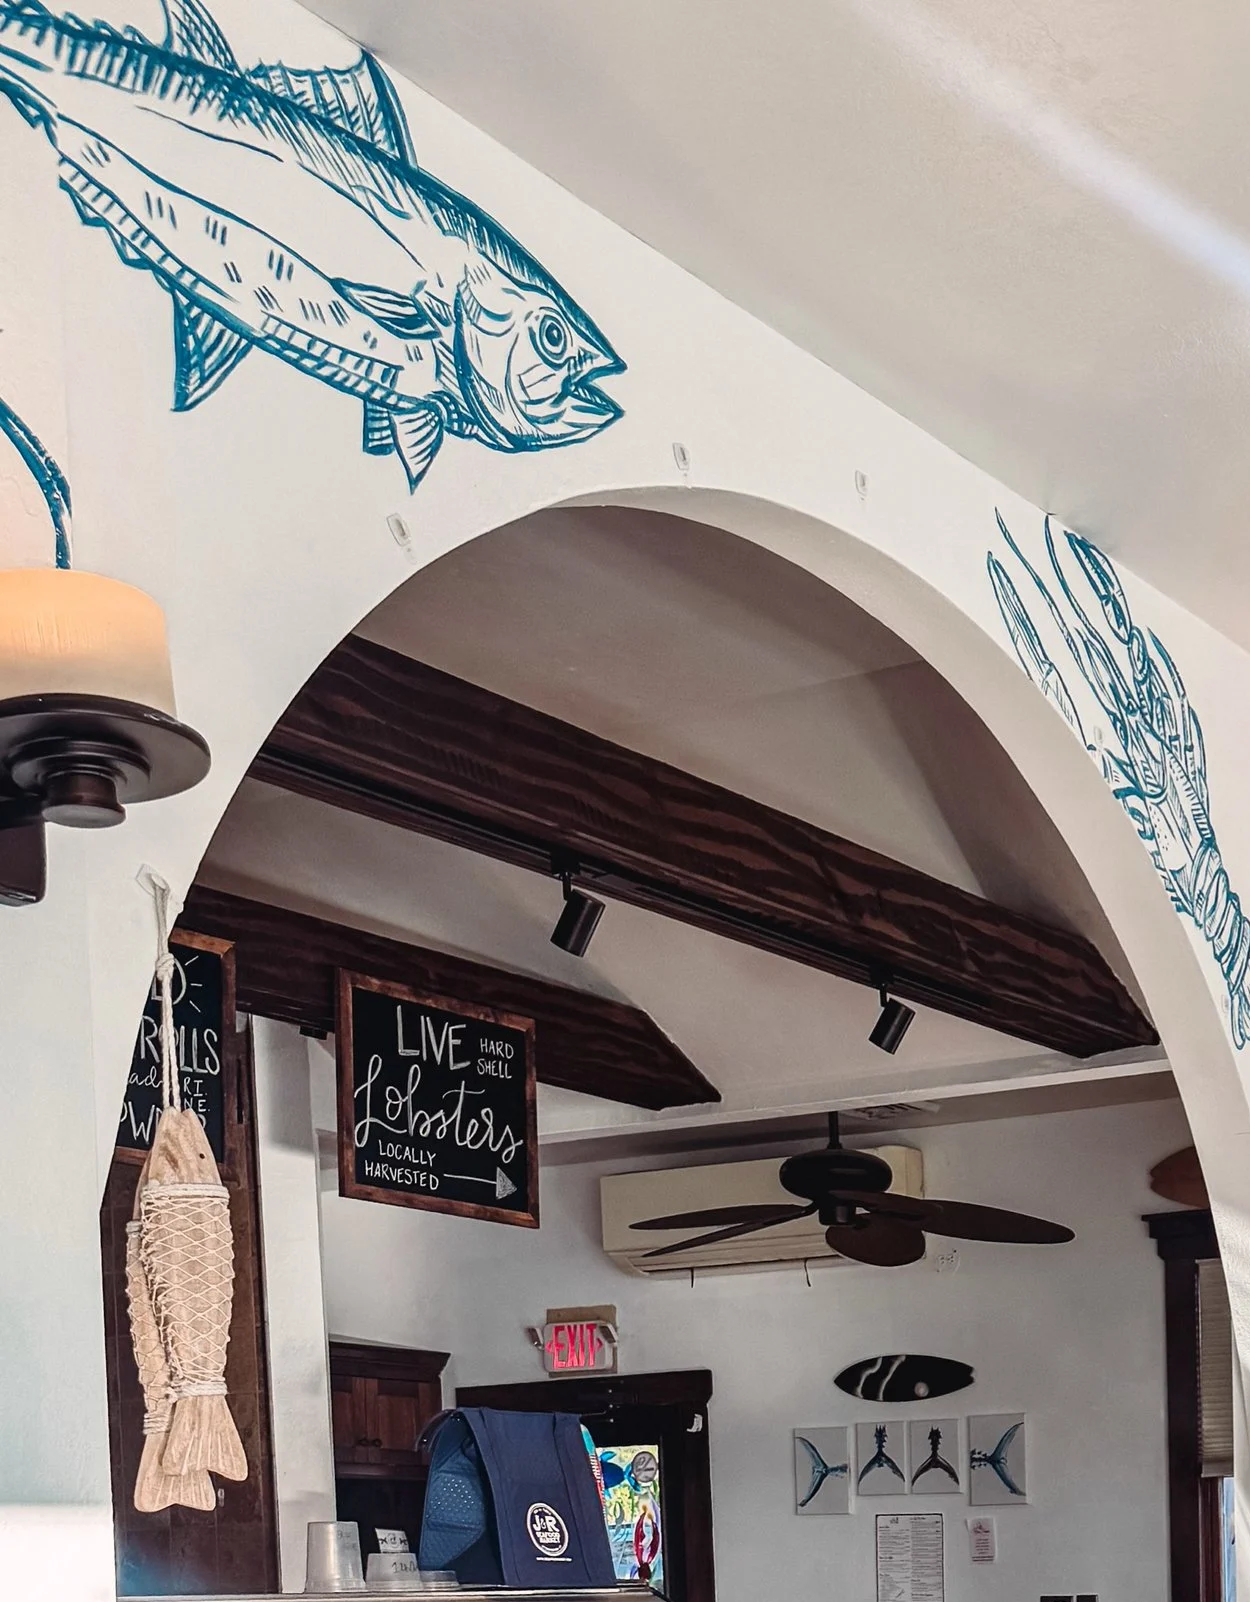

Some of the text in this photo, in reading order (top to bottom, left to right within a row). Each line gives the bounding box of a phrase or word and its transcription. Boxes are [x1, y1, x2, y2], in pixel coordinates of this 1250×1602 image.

[397, 1005, 471, 1070] LIVE
[479, 1038, 514, 1059] HARD
[477, 1058, 513, 1079] SHELL
[354, 1054, 524, 1163] Lobsters
[379, 1140, 437, 1167] LOCALLY
[364, 1160, 440, 1190] HARVESTED
[553, 1323, 597, 1369] EXIT
